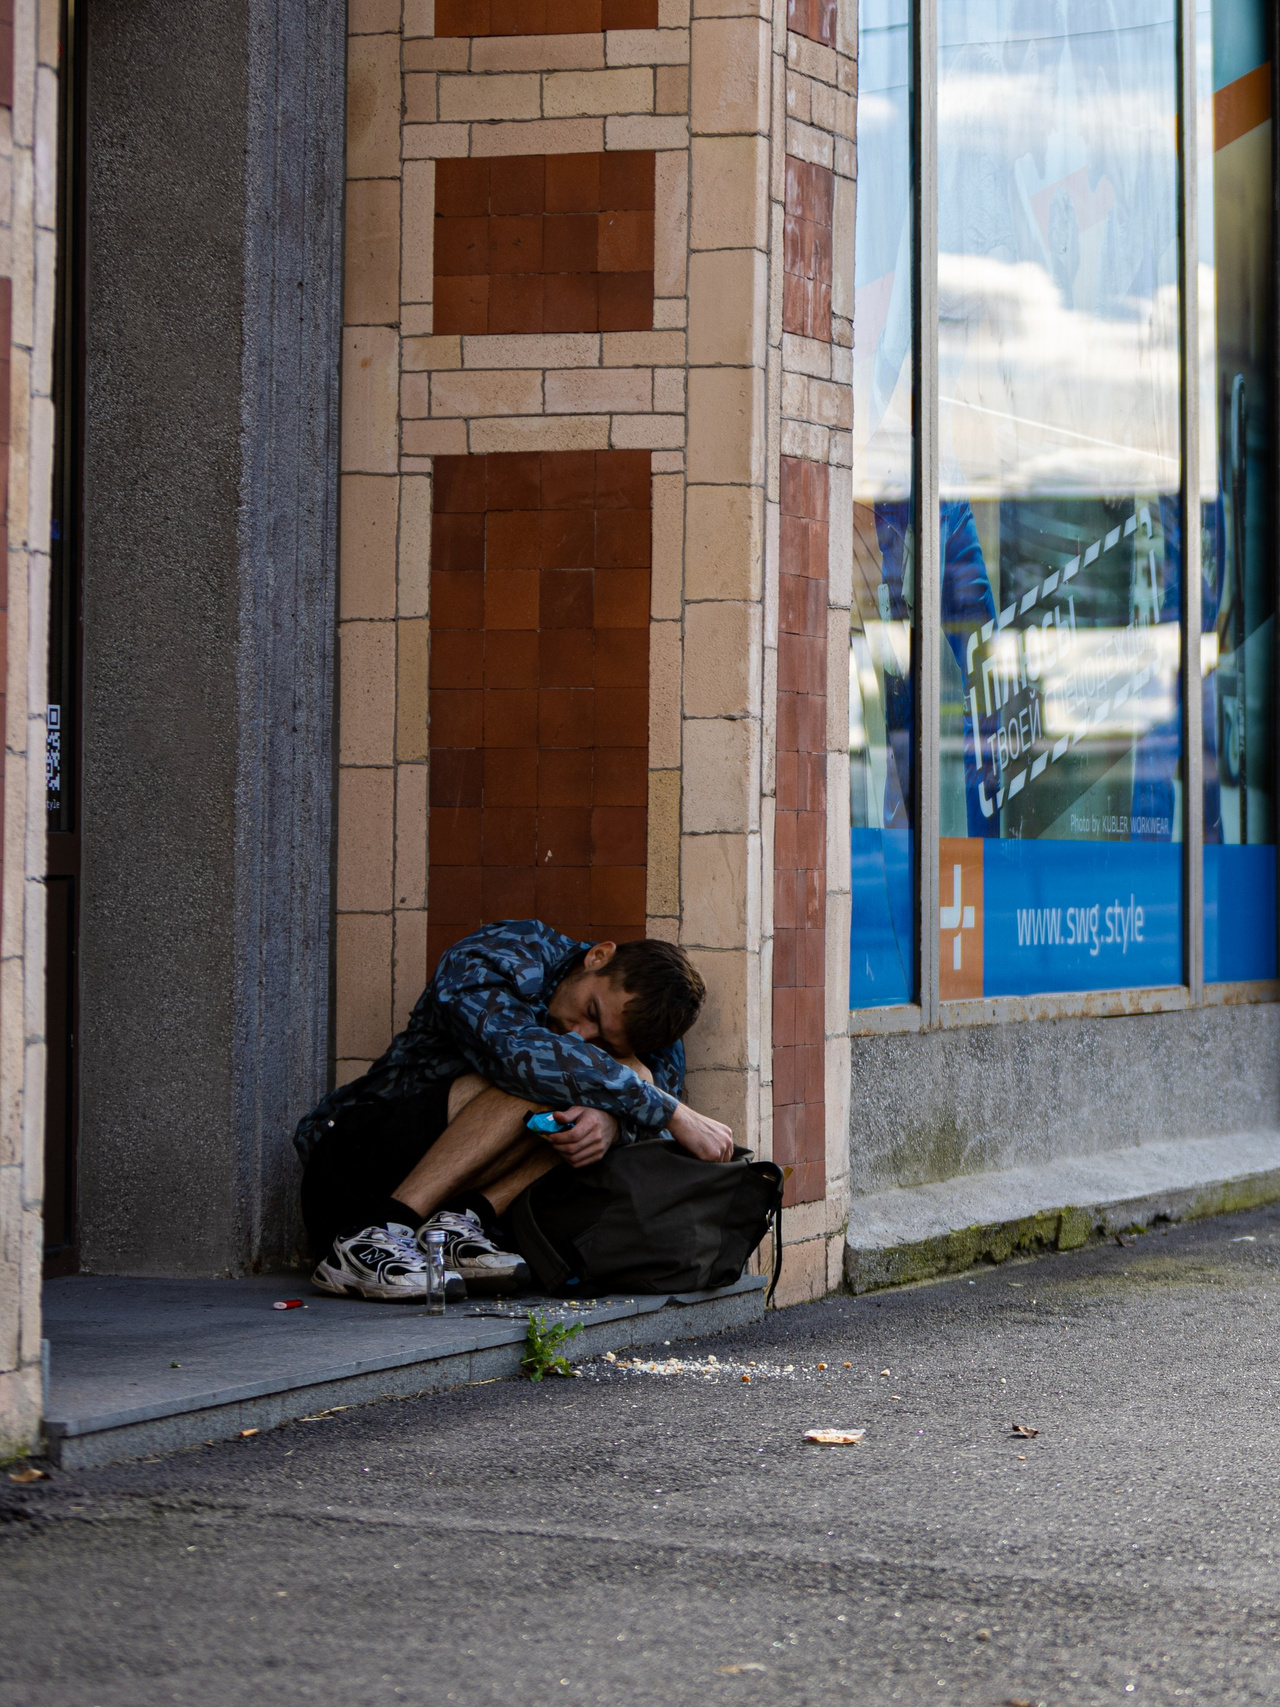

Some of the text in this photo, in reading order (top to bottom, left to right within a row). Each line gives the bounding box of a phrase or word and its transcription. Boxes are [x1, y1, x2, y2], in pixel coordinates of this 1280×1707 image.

[981, 594, 1077, 718] ПЛЮСЫ
[986, 688, 1042, 776] ТВОЕЙ
[1070, 814, 1090, 832] Photo
[1091, 814, 1100, 837] by
[1130, 816, 1170, 834] WORKWEAR
[1016, 892, 1145, 957] www.swg.style
[359, 1246, 386, 1264] N
